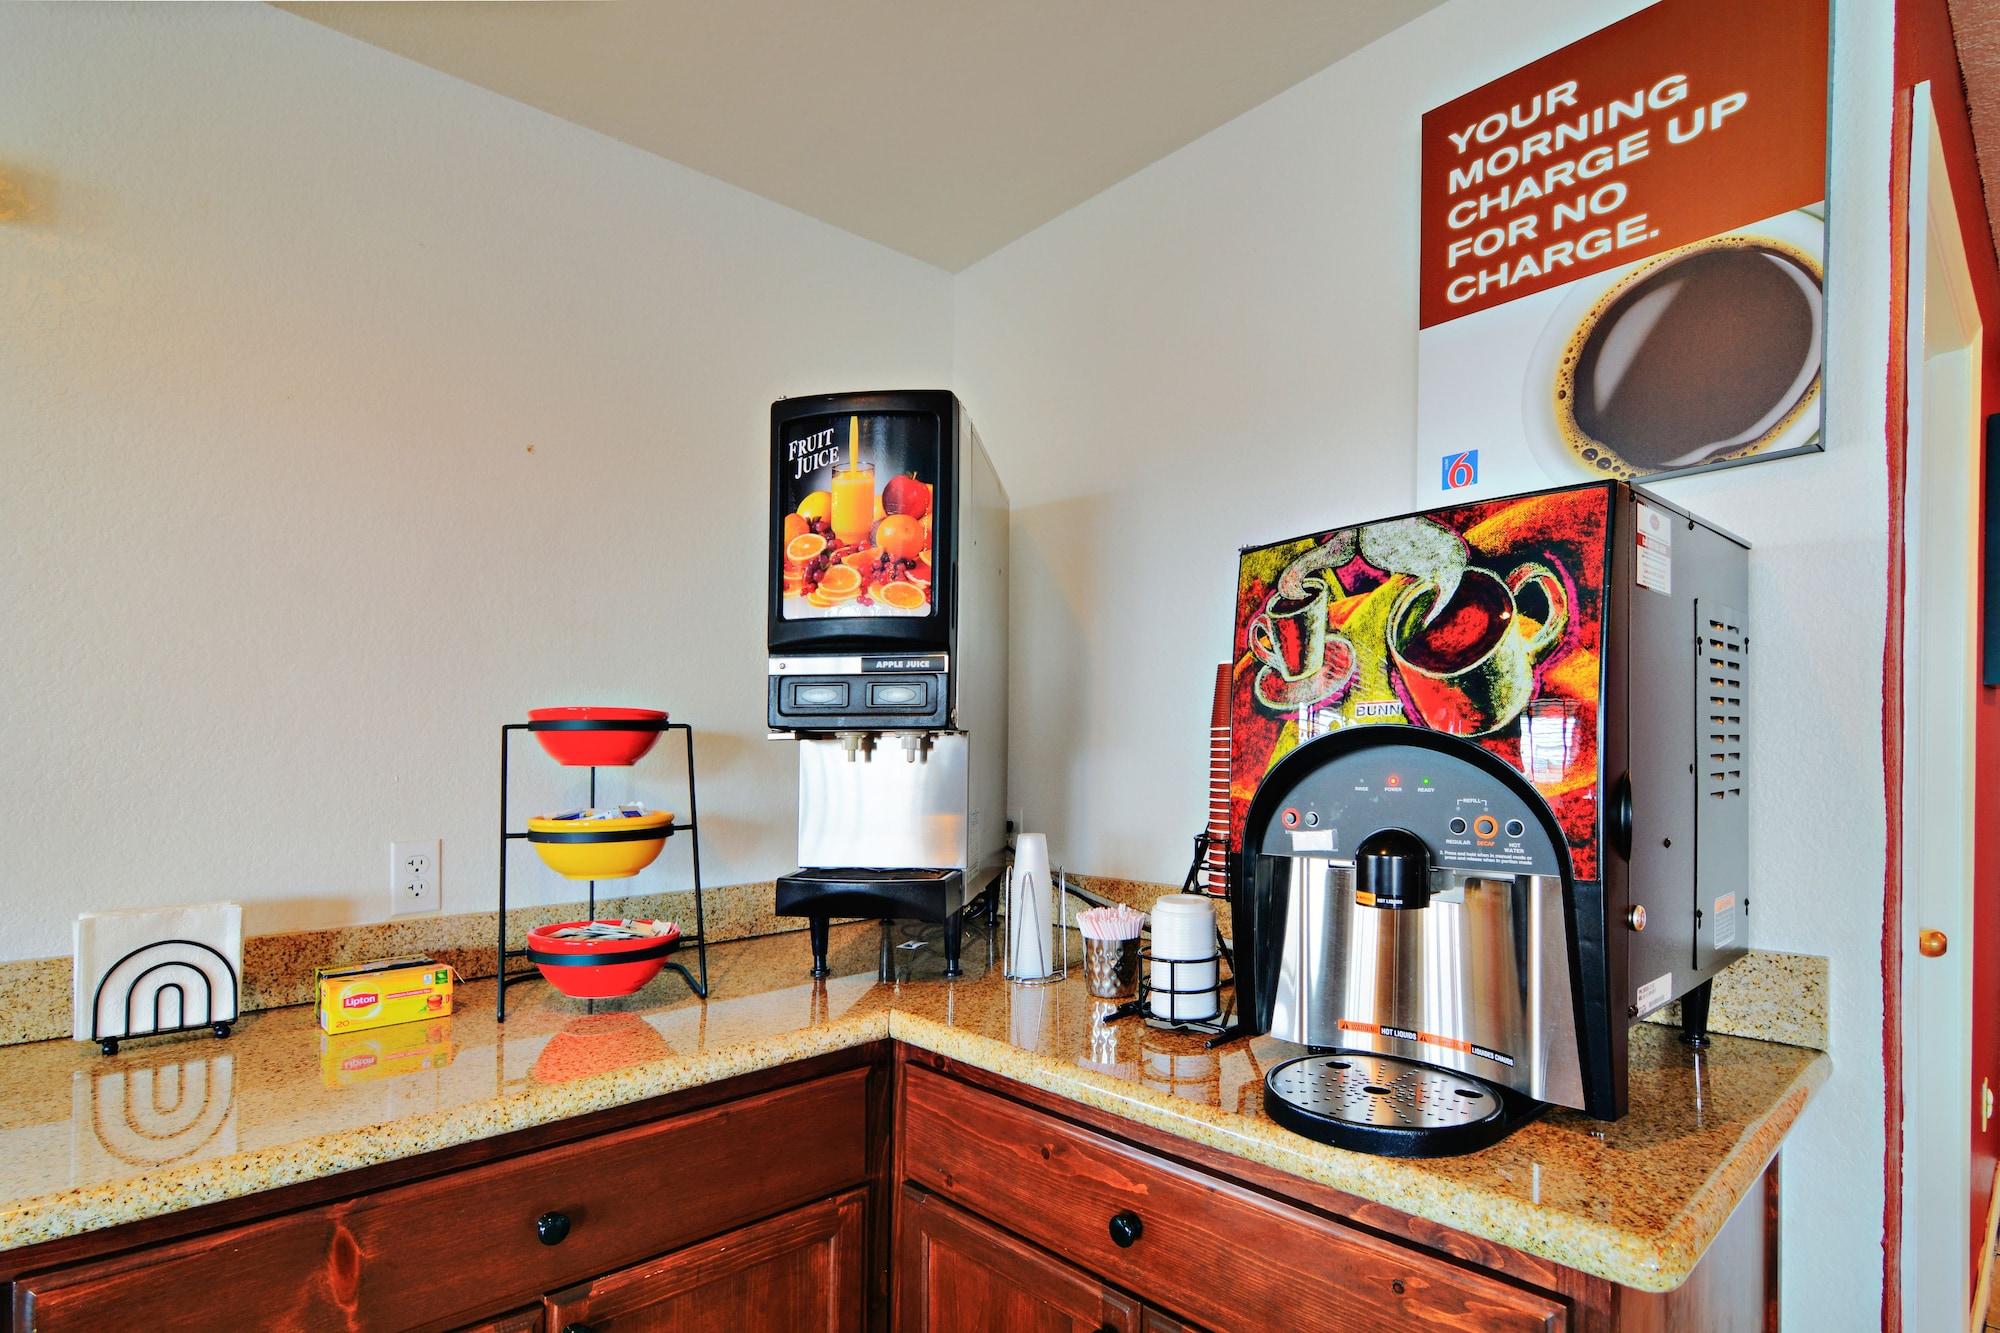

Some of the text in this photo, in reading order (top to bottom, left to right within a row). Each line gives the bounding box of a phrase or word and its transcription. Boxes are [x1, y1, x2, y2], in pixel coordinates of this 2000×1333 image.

[1448, 80, 1578, 154] YOUR
[1449, 74, 1687, 195] MORNING
[1448, 91, 1747, 229] CHARGE UP
[1449, 183, 1627, 269] FOR NO
[1447, 213, 1660, 304] CHARGE.
[788, 427, 834, 462] FRUIT
[794, 446, 839, 479] JUICE
[1448, 451, 1474, 489] 6
[876, 660, 930, 668] APPLE JUICE
[1356, 703, 1400, 717] BUNN
[346, 996, 376, 1007] Lipton
[336, 1020, 349, 1028] 20
[1381, 1027, 1394, 1036] HOT
[1394, 1030, 1417, 1041] LIQUIDS
